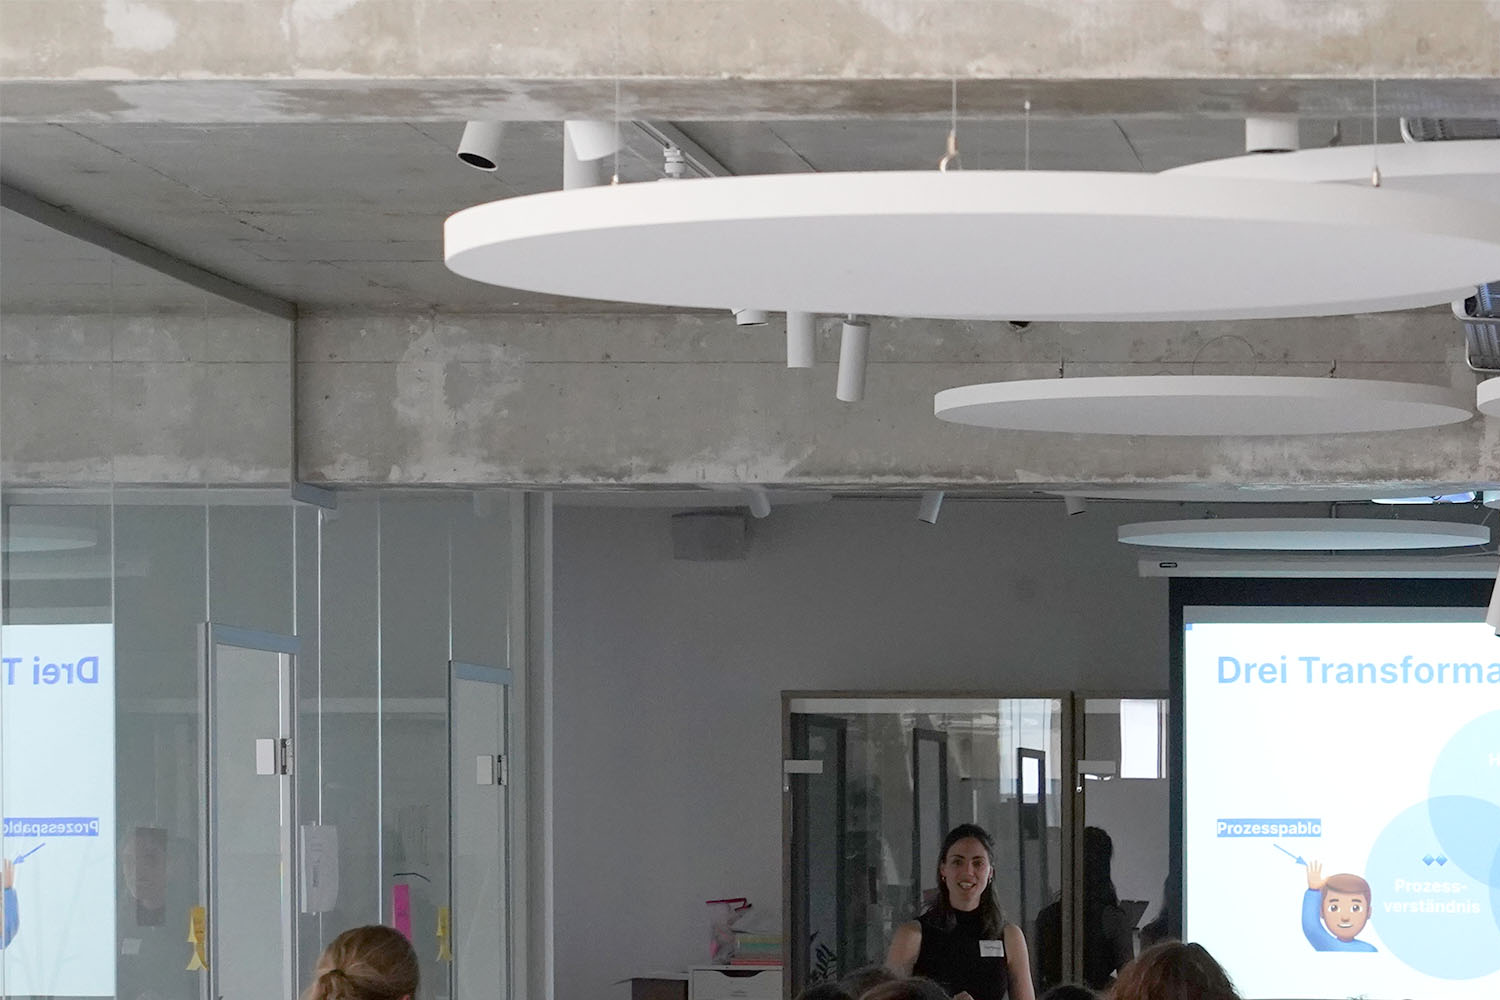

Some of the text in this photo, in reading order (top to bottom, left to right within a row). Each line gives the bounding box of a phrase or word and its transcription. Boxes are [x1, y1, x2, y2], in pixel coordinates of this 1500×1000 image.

[1217, 655, 1288, 684] Drei
[1217, 821, 1321, 837] Prozesspablo
[1394, 878, 1468, 894] Prozess-
[1384, 896, 1481, 914] verständnis
